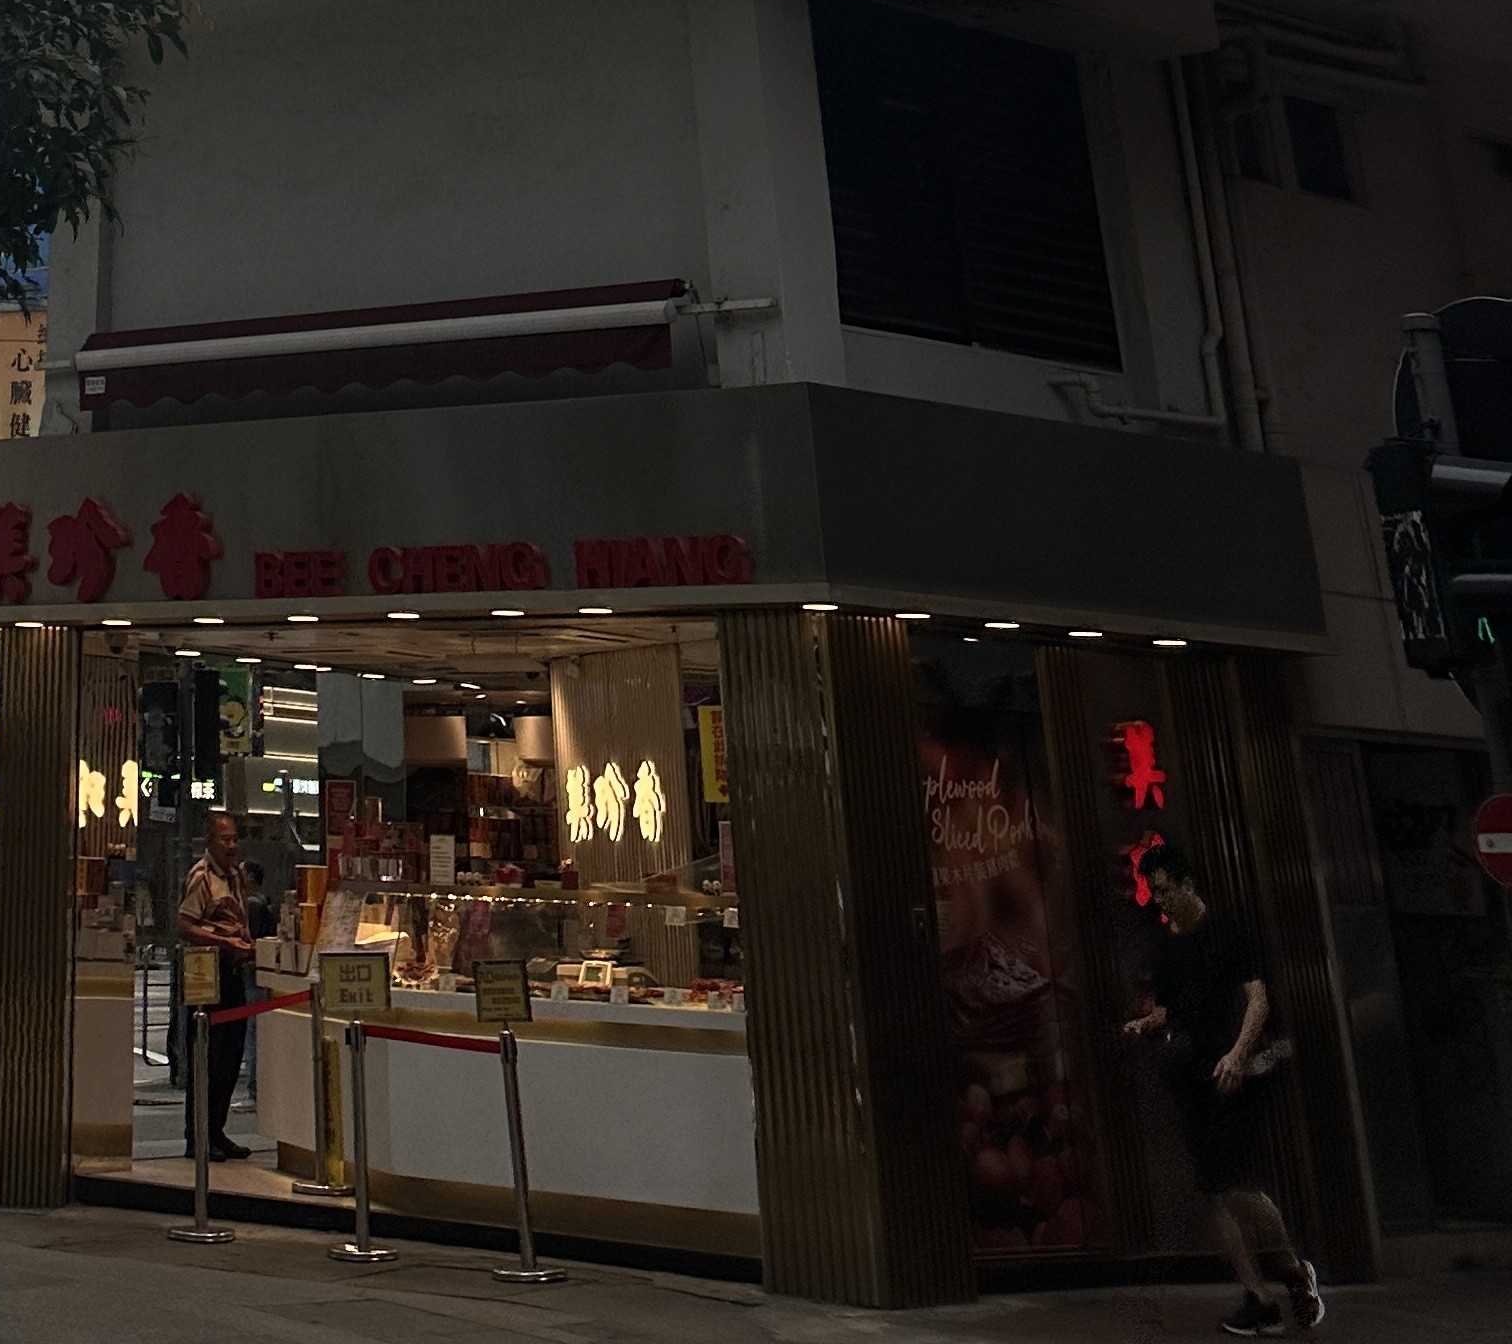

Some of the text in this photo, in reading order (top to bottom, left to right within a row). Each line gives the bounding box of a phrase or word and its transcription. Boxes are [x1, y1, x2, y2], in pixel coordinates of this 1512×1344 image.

[255, 534, 756, 599] BEE CHENG HIANG
[565, 761, 666, 843] 美珍香
[931, 804, 986, 853] Sliced
[339, 964, 373, 982] 出口
[339, 989, 374, 1004] Exit
